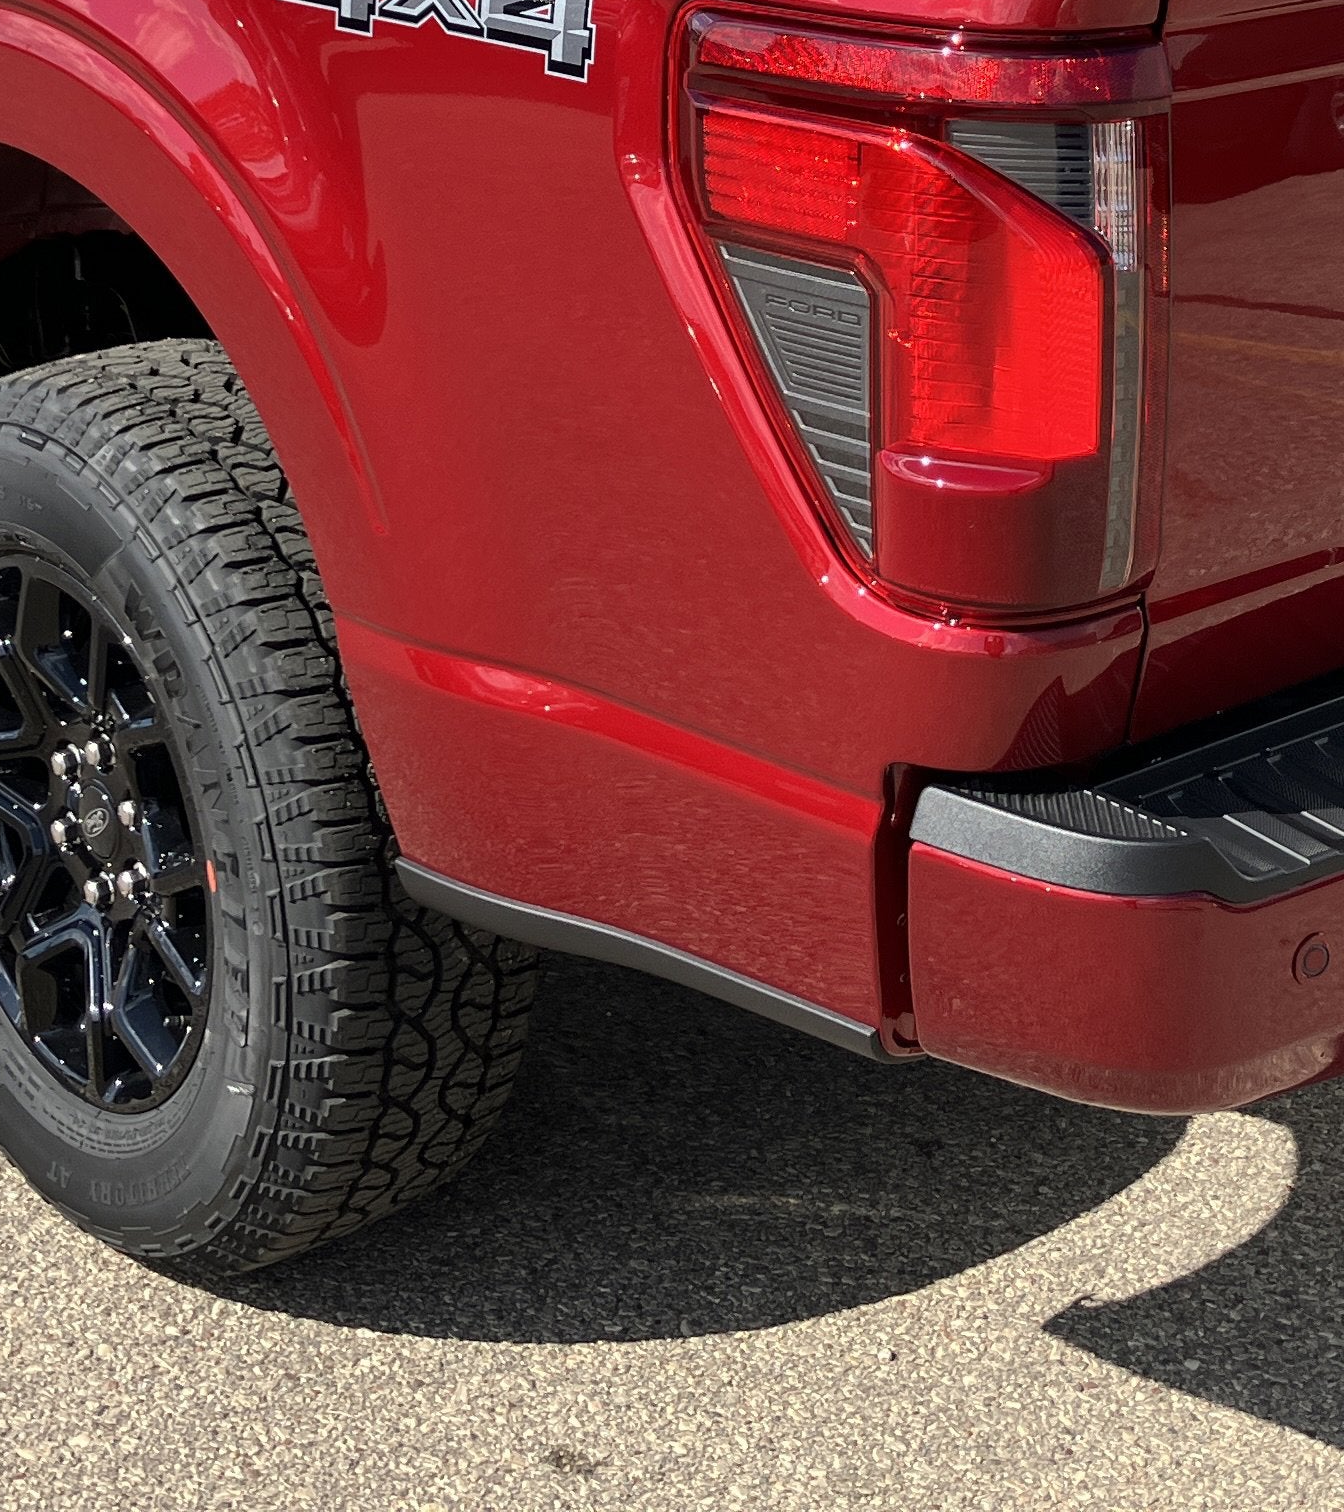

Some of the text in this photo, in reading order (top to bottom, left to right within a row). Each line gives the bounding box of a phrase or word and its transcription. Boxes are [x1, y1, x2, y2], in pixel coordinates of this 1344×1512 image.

[765, 293, 862, 327] FORD
[123, 579, 253, 1050] WRANGLER
[46, 1160, 192, 1207] TERRITORY AT
